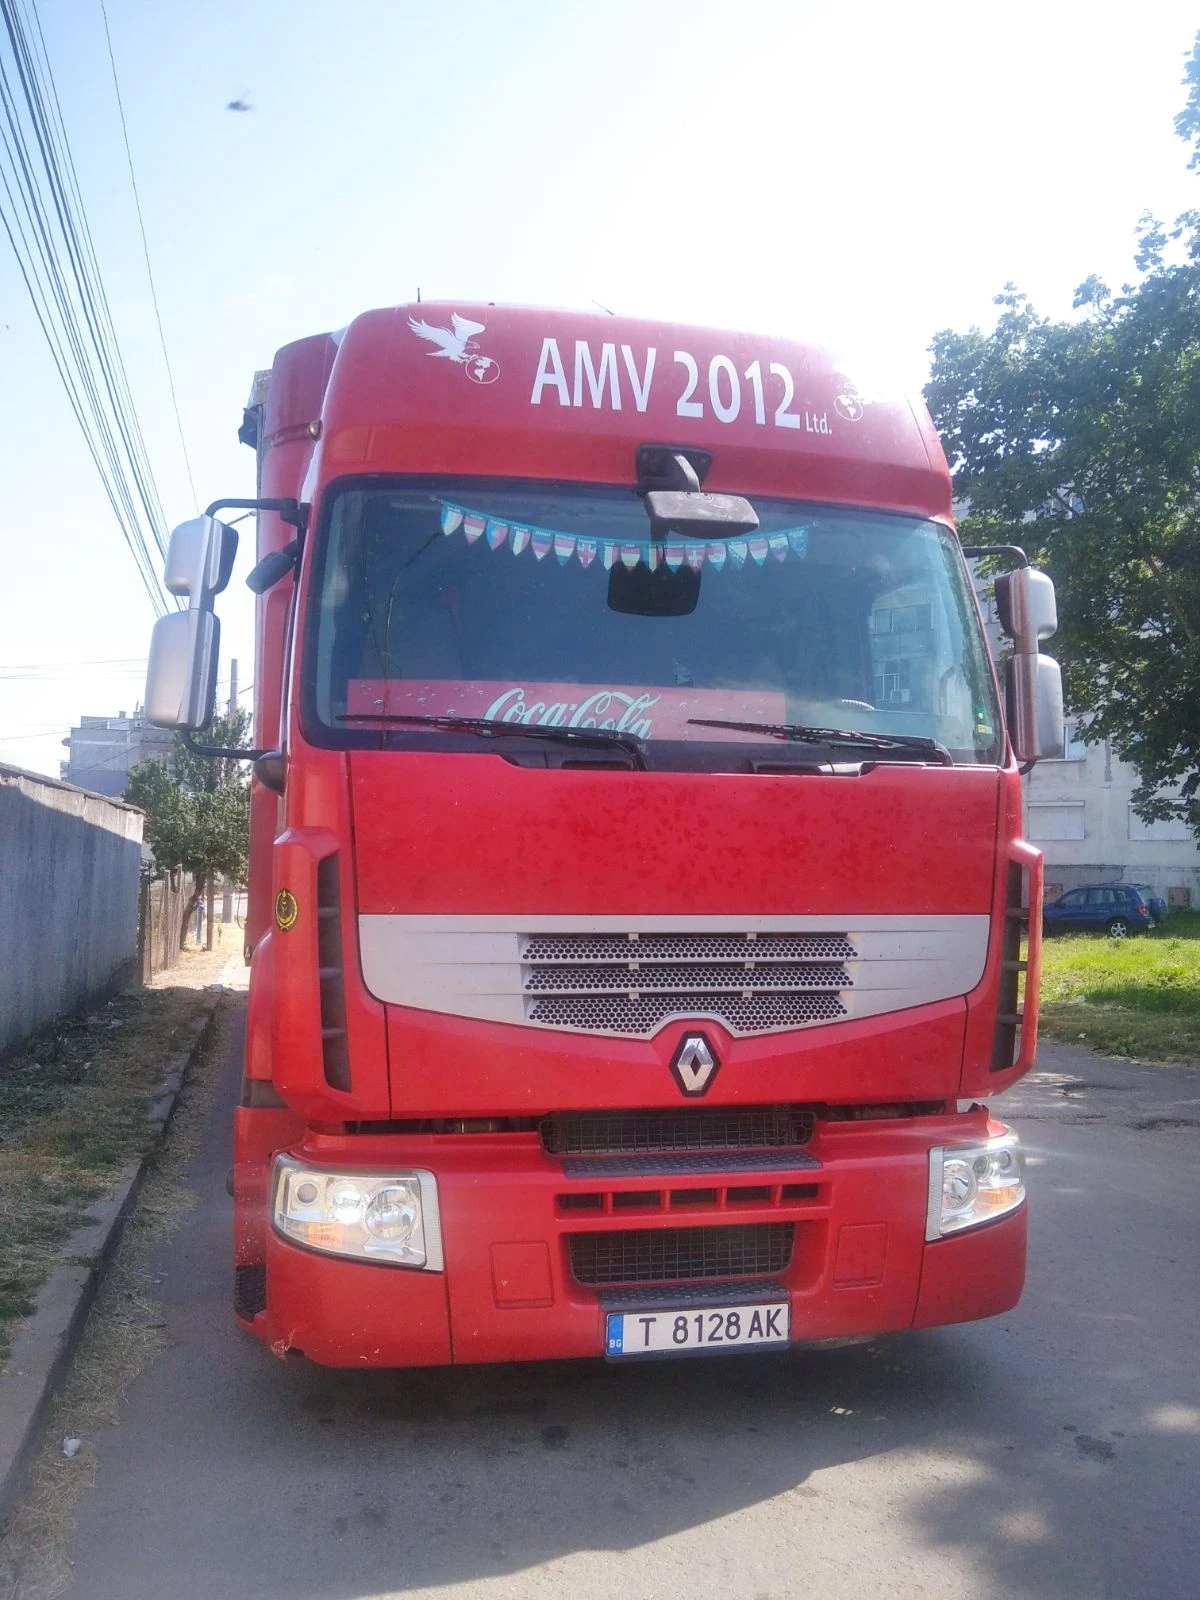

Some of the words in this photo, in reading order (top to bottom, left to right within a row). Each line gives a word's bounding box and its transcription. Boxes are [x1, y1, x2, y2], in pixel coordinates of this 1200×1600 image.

[530, 337, 656, 413] AMV
[674, 350, 800, 429] 2012
[805, 411, 833, 435] Ltd.
[484, 687, 662, 739] Coca-Cola
[609, 1338, 622, 1348] BG
[638, 1317, 657, 1346] T
